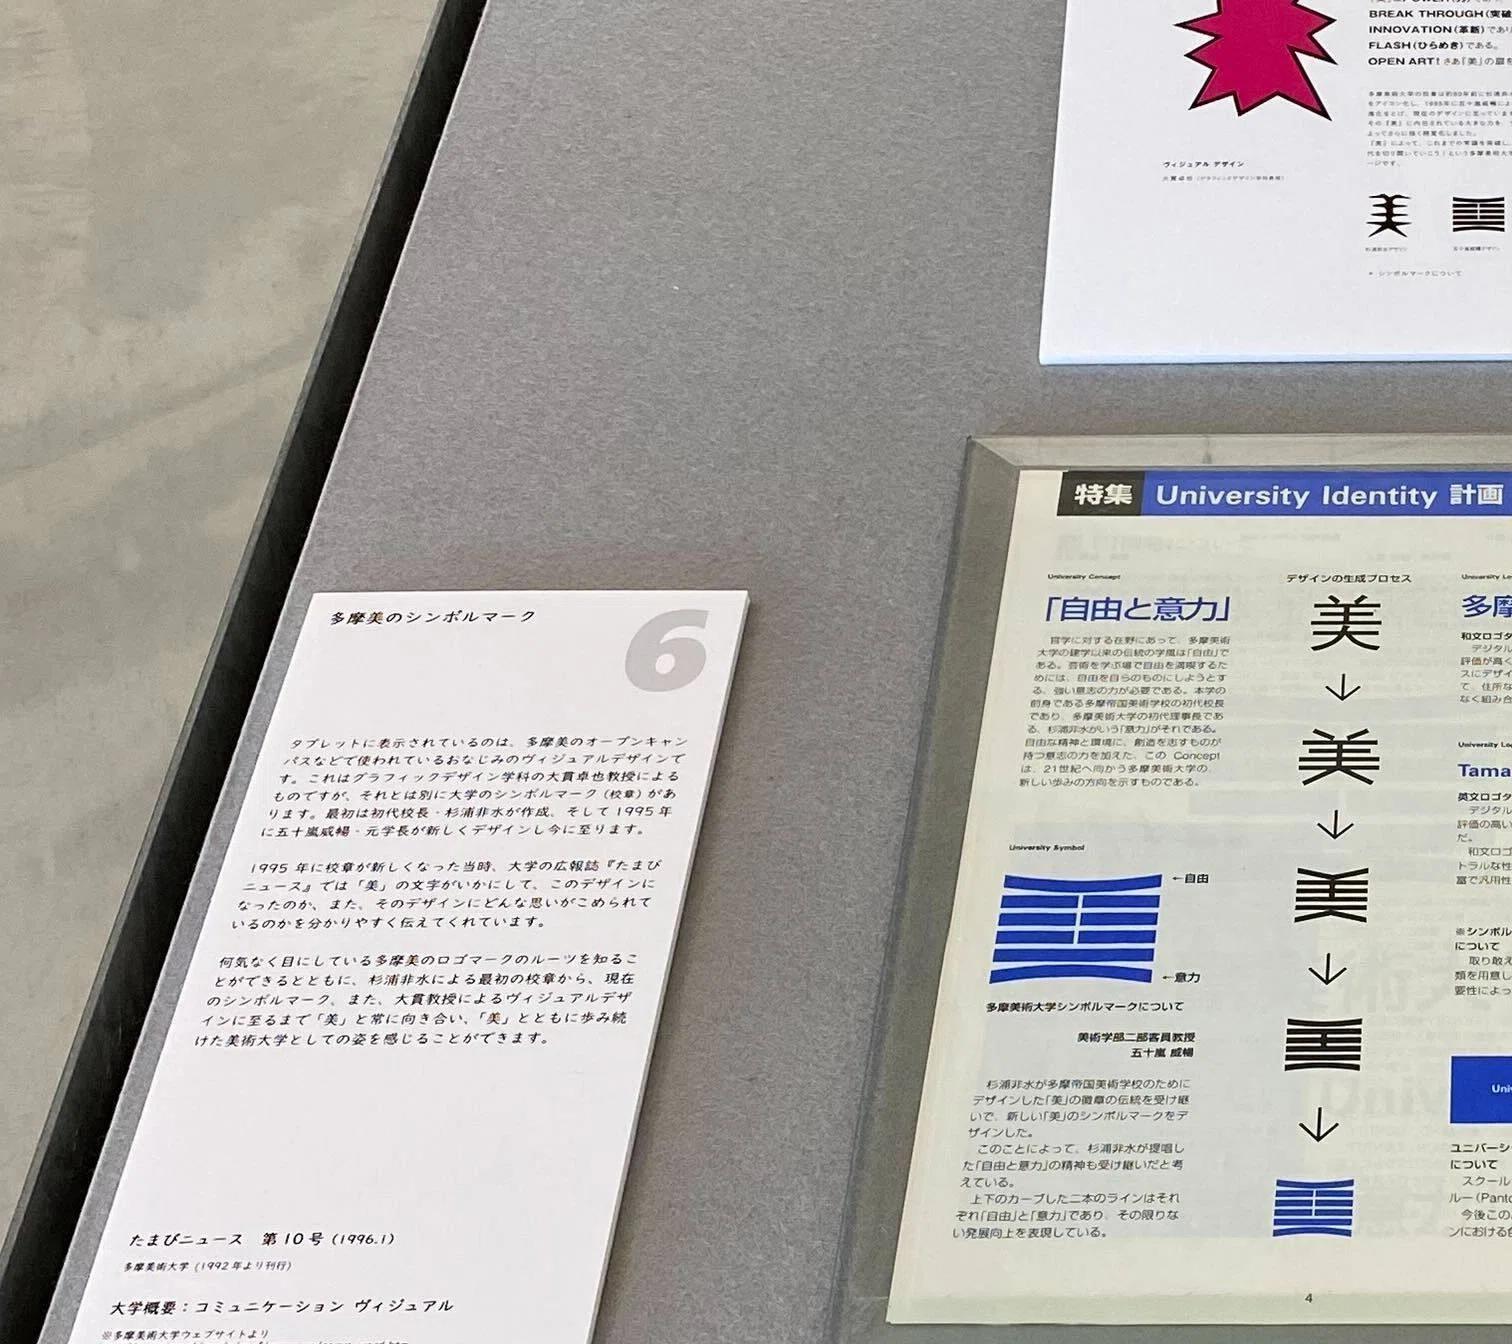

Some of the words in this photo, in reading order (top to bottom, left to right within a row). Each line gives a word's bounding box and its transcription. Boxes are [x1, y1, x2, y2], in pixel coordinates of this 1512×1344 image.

[1369, 10, 1414, 18] BREAK
[1368, 57, 1406, 66] OPEN
[1213, 160, 1245, 168] デザイン
[1074, 483, 1133, 506] 特集
[1156, 483, 1310, 510] University
[1322, 482, 1437, 509] Identity
[1449, 482, 1504, 506] 計画
[1286, 573, 1412, 584] デザインの生成プロセス
[1045, 596, 1231, 622] 「自由と意力」
[329, 608, 537, 627] 多摩美のシンボルマーク
[1311, 596, 1382, 652] 美
[624, 609, 709, 693] 6
[1173, 751, 1221, 761] Concept
[1457, 763, 1512, 777] Tama
[616, 807, 655, 818] 1995
[659, 806, 673, 818] 年
[1457, 833, 1473, 843] だ。
[251, 862, 288, 874] 1995
[1184, 873, 1209, 884] 自由
[237, 897, 651, 911] なったのか、また、そのデザインにどんな思いがこめられて
[232, 915, 549, 930] いるのかを分かりやすく伝えてくれています。
[1454, 942, 1500, 951] について
[1173, 972, 1200, 983] 意力
[986, 1002, 1185, 1013] 多摩美術大学シンボルマークについて
[194, 1031, 552, 1047] けた美術大学としての姿を感じることができます。
[1077, 1032, 1196, 1043] 美術学部二部客員教授
[1130, 1048, 1166, 1058] 五十嵐
[968, 1127, 1033, 1138] ザインした。
[1450, 1159, 1498, 1169] について
[959, 1176, 1015, 1188] えている。
[952, 1227, 1107, 1239] い発展向上を表現している。
[129, 1233, 243, 1246] たまびニュース
[262, 1232, 278, 1246] 第
[284, 1233, 304, 1246] 10
[309, 1232, 325, 1246] 号
[124, 1261, 189, 1272] 多摩美術大学
[1304, 1293, 1313, 1303] 4
[354, 1298, 454, 1313] ヴィジュアル
